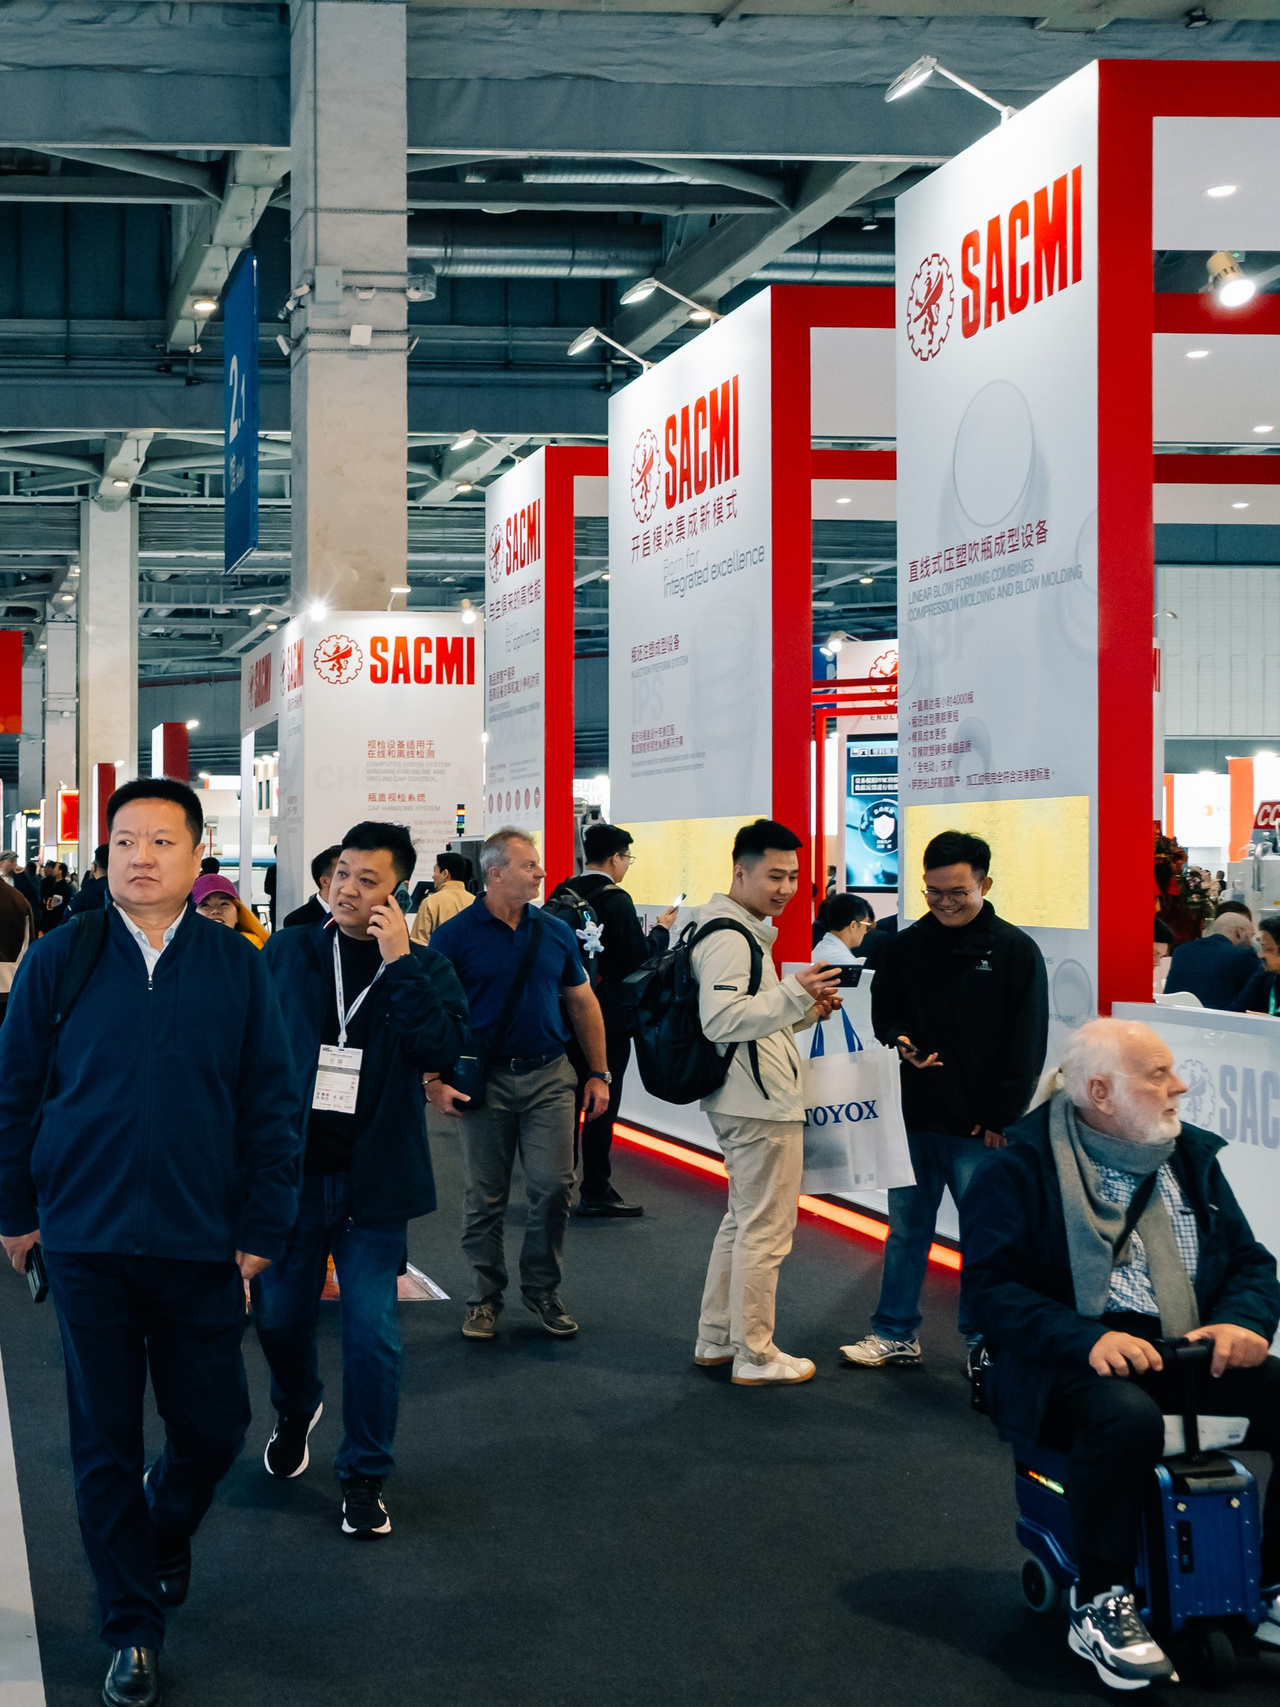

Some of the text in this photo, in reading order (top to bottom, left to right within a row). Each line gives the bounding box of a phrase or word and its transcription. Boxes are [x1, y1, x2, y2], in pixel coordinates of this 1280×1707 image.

[961, 164, 1082, 339] SACMI
[665, 374, 739, 510] SACMI
[505, 498, 541, 576] SACMI
[908, 519, 1048, 583] 直线式压塑吹瓶成型设备
[663, 545, 765, 599] integrated excellence
[908, 558, 1035, 605] LINEAR BLOW FORMING COMBINES
[908, 564, 1083, 622] COMPRESSION MOLDING AND BLOW MOLDING
[369, 635, 475, 685] SACMI
[367, 739, 435, 749] 视检设备适用于
[367, 749, 435, 759] 在线和离线检测
[368, 793, 426, 803] 瓶盖视检系统
[804, 1099, 879, 1127] TOYOX
[1220, 1064, 1280, 1149] SAC
